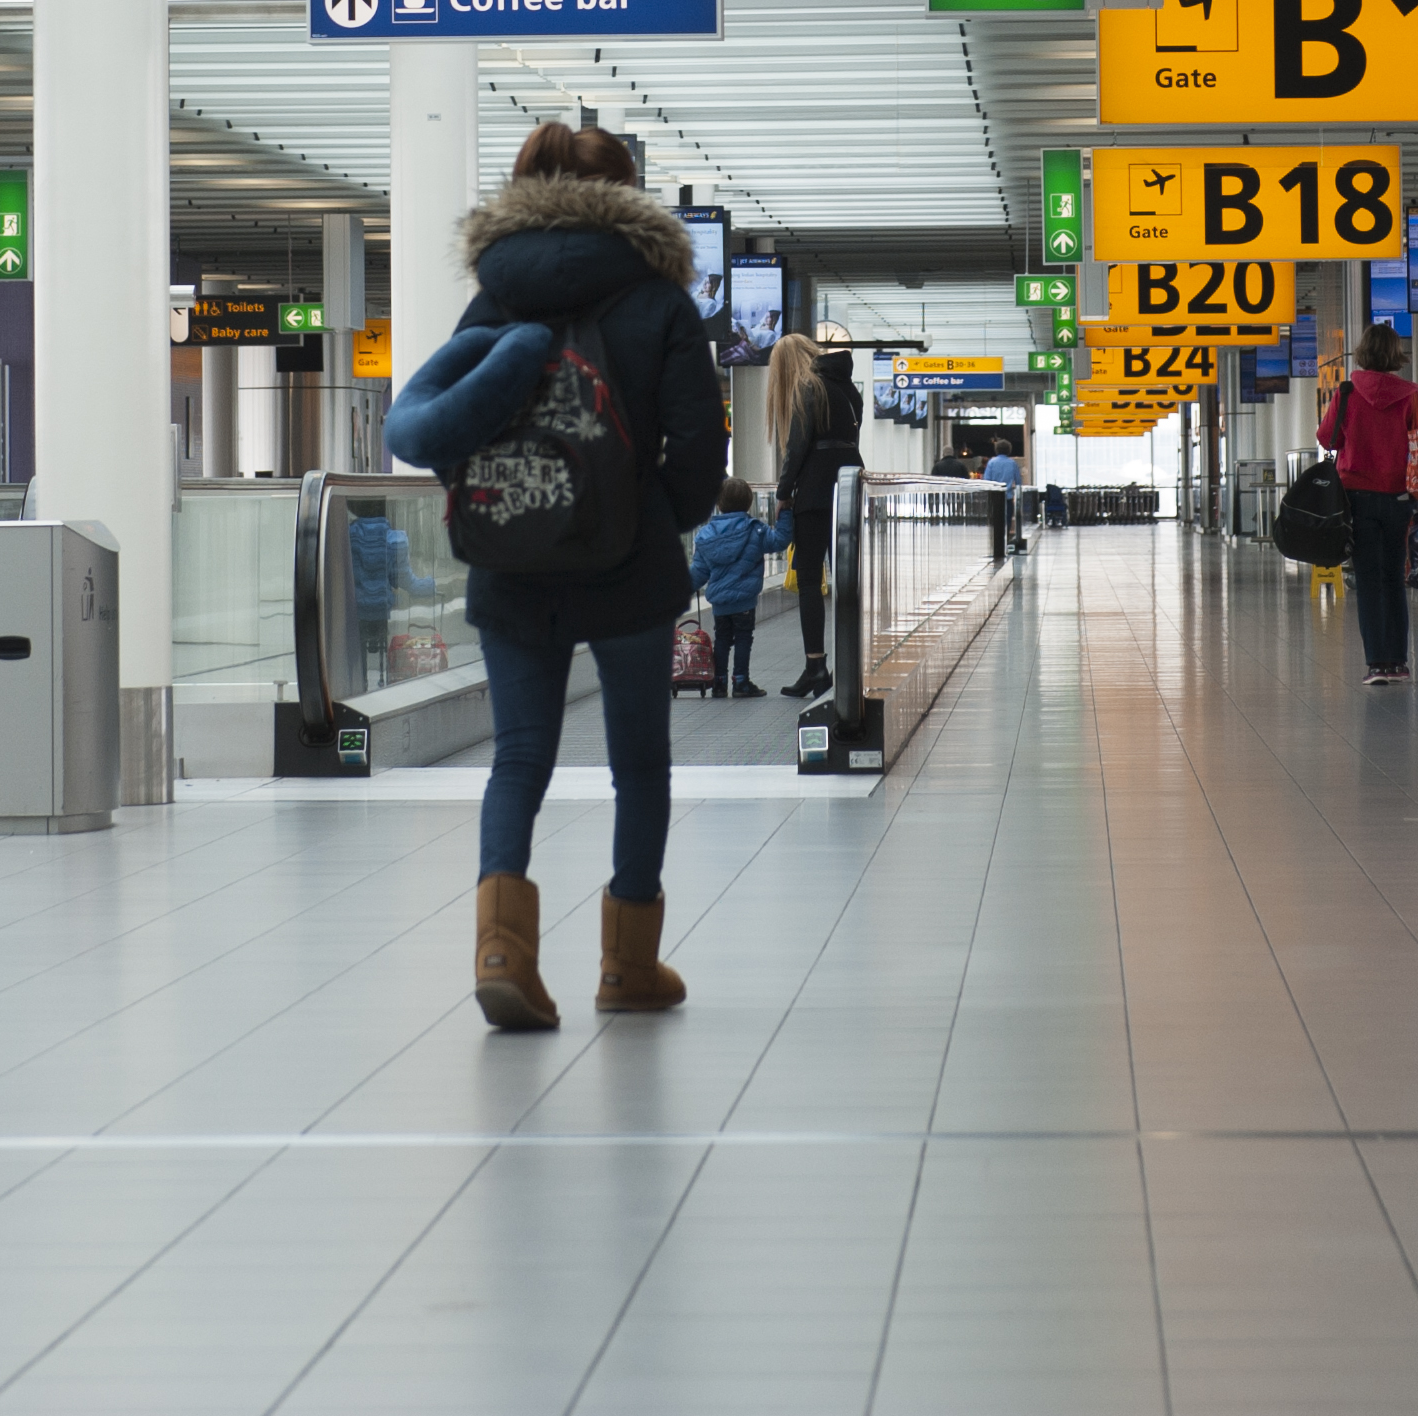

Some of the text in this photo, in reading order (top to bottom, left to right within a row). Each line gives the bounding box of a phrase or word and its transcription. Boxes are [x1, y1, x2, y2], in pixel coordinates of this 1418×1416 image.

[1155, 67, 1217, 89] Gate
[1203, 159, 1394, 245] B18
[1129, 224, 1169, 239] Gate
[1137, 262, 1275, 315] B20
[226, 302, 265, 313] Toilets
[211, 327, 269, 340] Baby care
[1123, 348, 1214, 378] B24
[923, 377, 964, 385] Coffee bar
[466, 457, 554, 485] SURFER
[503, 483, 575, 515] BOYS
